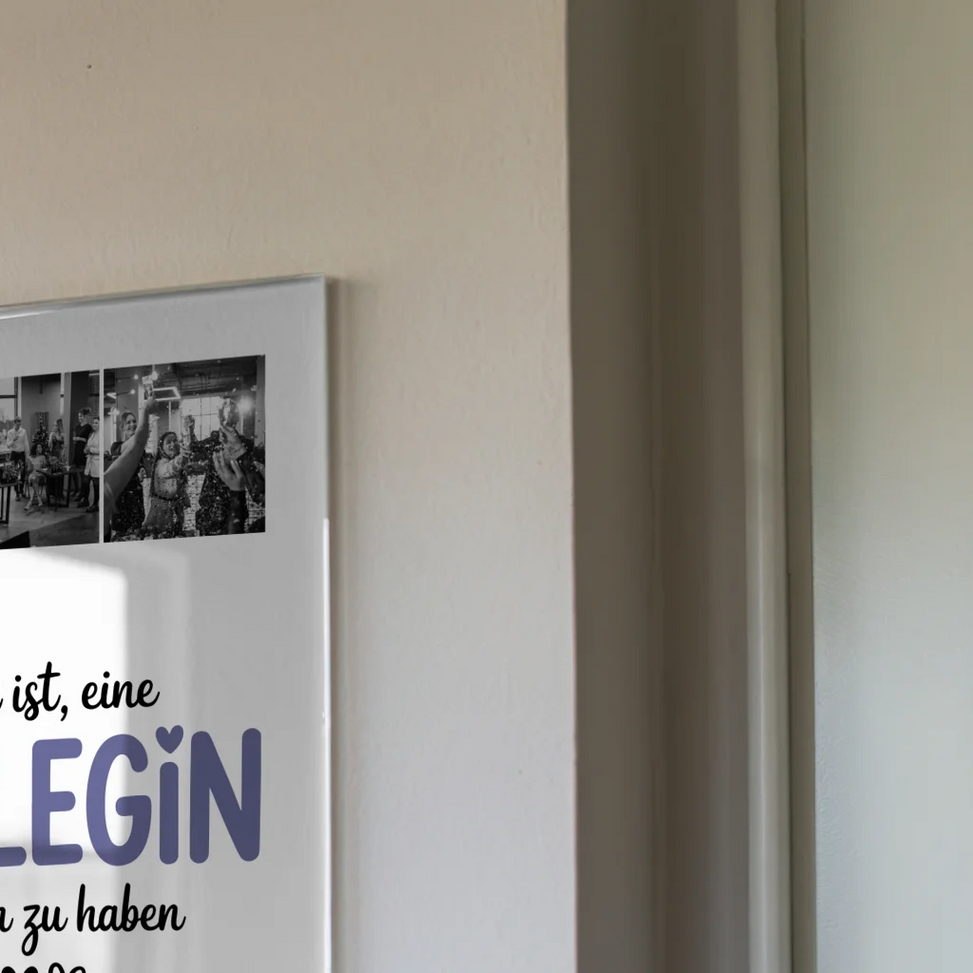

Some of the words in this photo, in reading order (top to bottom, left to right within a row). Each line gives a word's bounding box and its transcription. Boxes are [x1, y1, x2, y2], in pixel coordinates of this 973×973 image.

[12, 661, 68, 722] ist,
[81, 671, 160, 710] eine
[21, 904, 69, 957] zu
[76, 882, 187, 933] haben
